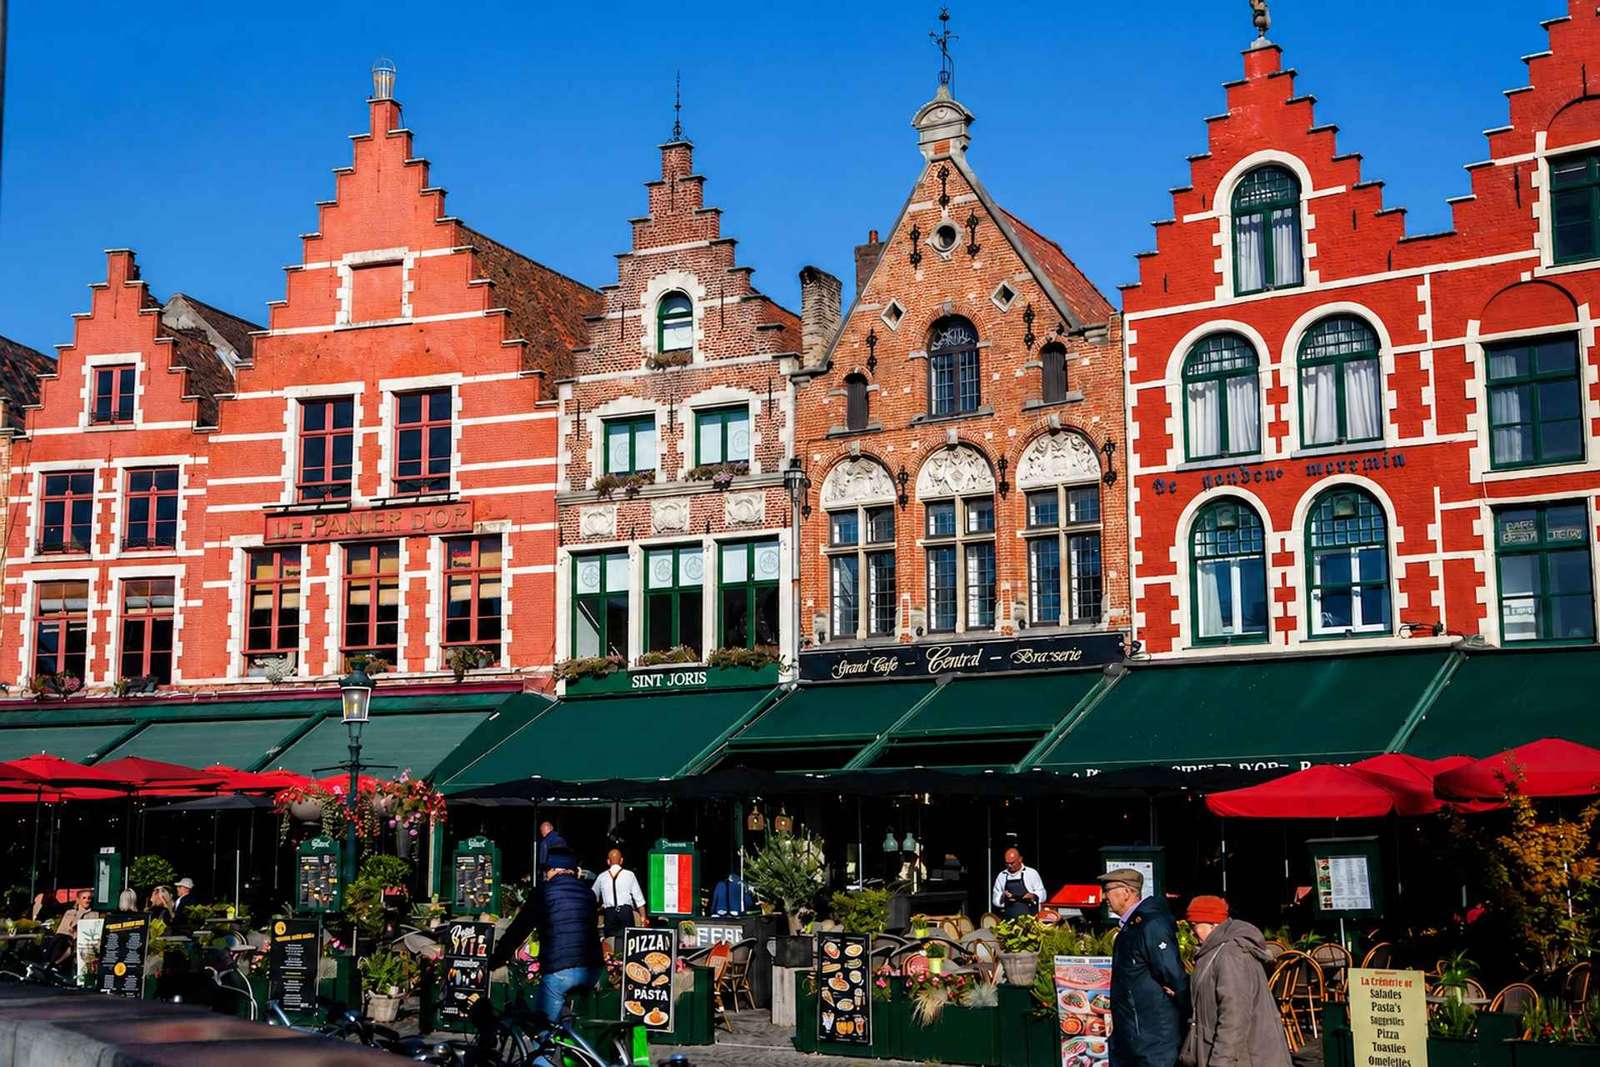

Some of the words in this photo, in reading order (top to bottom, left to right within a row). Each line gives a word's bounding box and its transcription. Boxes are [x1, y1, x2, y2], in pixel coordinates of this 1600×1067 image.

[269, 519, 303, 540] LE
[310, 510, 400, 538] PANIER
[411, 506, 469, 530] D'OR
[831, 658, 870, 679] Grand
[926, 646, 984, 674] Central
[632, 673, 664, 689] SINT
[666, 671, 707, 687] JORIS
[634, 988, 669, 1001] PASTA
[1369, 988, 1402, 1000] Salades
[1371, 1001, 1402, 1014] Pasta's
[1376, 1028, 1400, 1040] Pizza
[1371, 1041, 1407, 1054] Toasties
[1368, 1055, 1412, 1067] Omelettes
